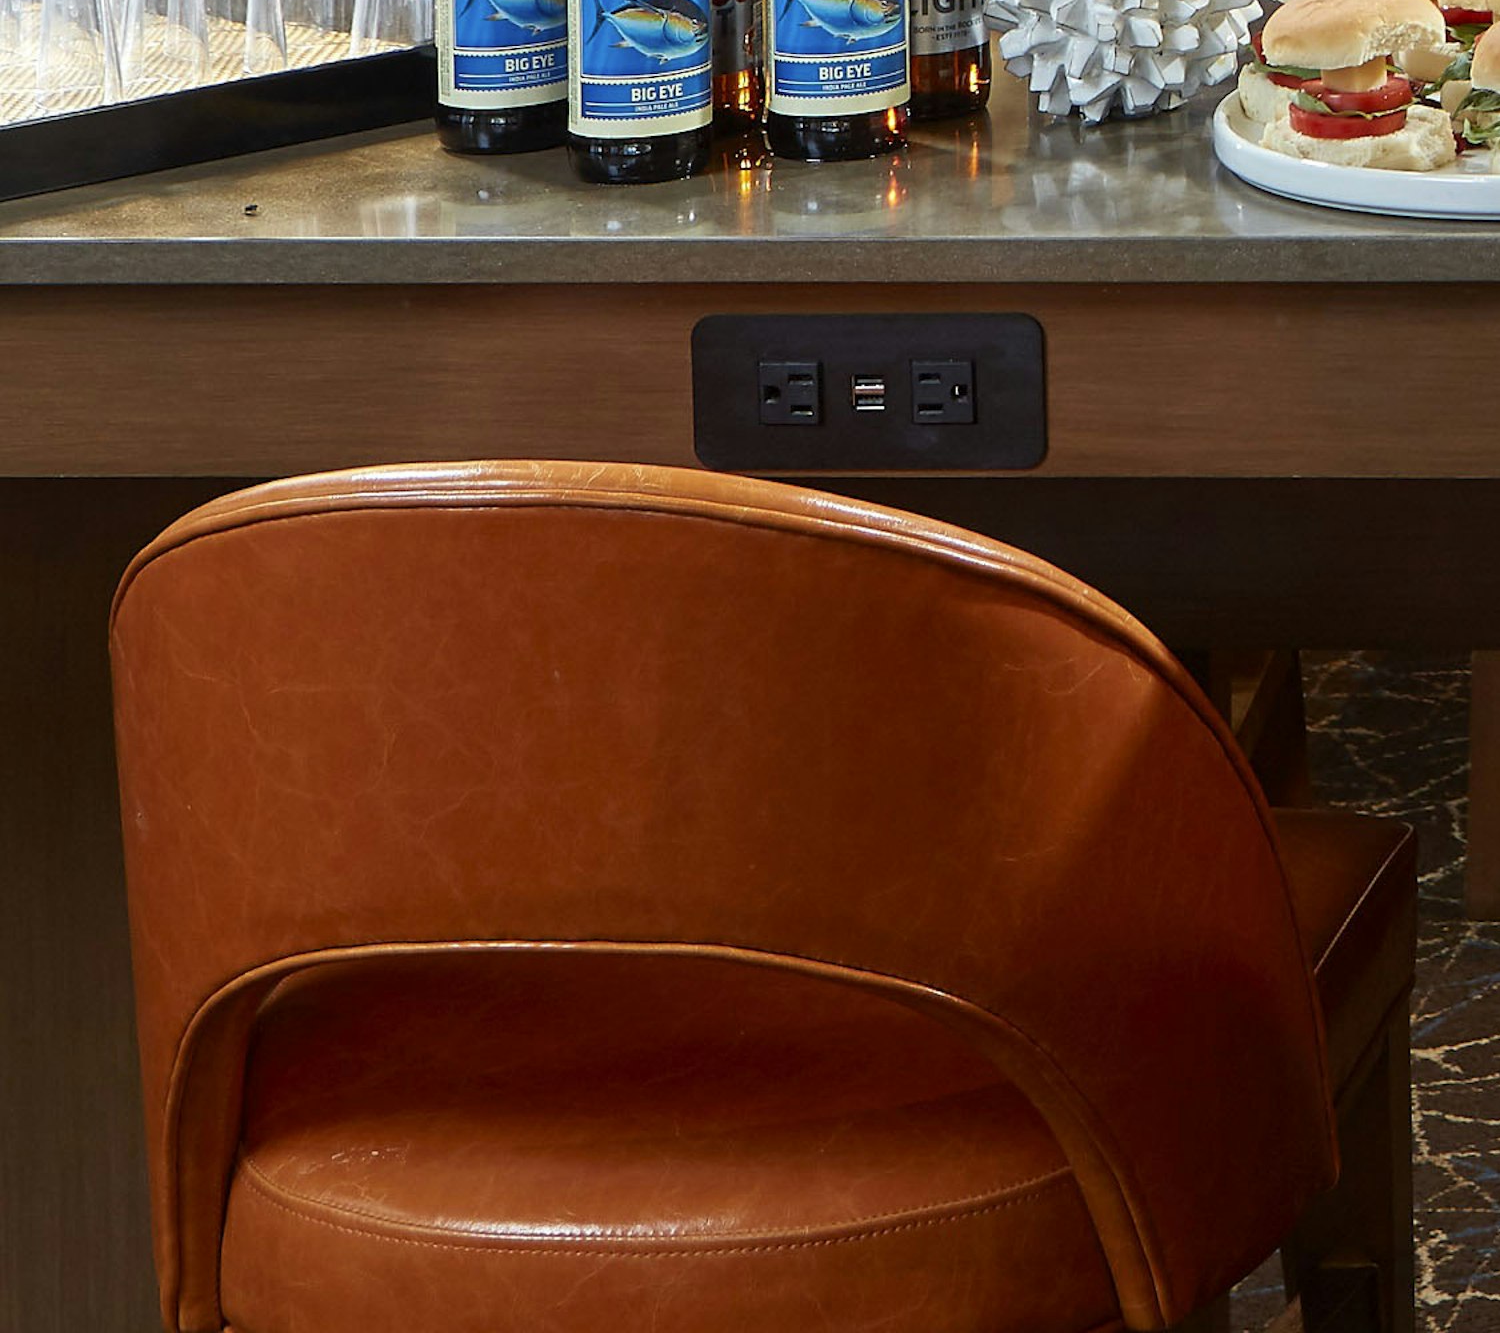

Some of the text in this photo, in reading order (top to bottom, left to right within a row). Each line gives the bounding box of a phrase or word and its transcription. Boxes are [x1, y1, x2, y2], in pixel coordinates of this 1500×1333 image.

[504, 53, 555, 73] BIG EYE
[819, 63, 872, 81] BIG EYE
[631, 83, 683, 102] BIG EYE
